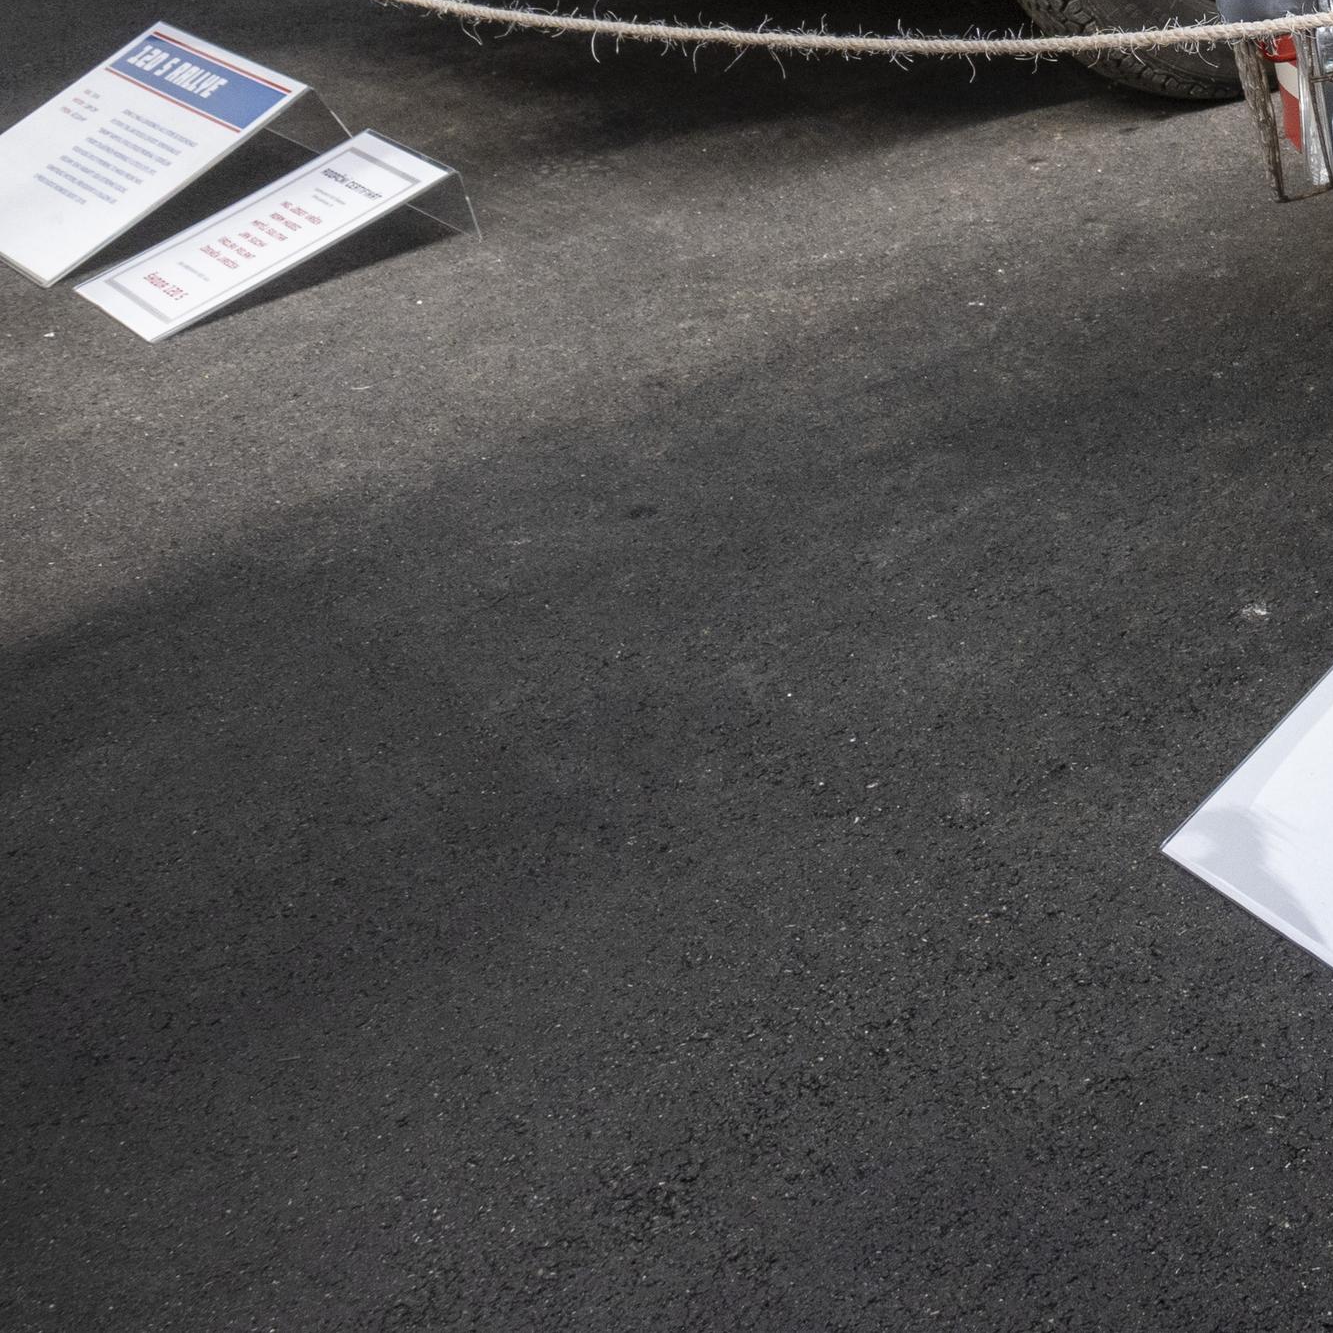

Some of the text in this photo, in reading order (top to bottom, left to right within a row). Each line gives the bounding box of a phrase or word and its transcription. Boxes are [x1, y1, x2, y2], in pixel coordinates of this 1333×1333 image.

[126, 44, 229, 99] 120 S RALLYE
